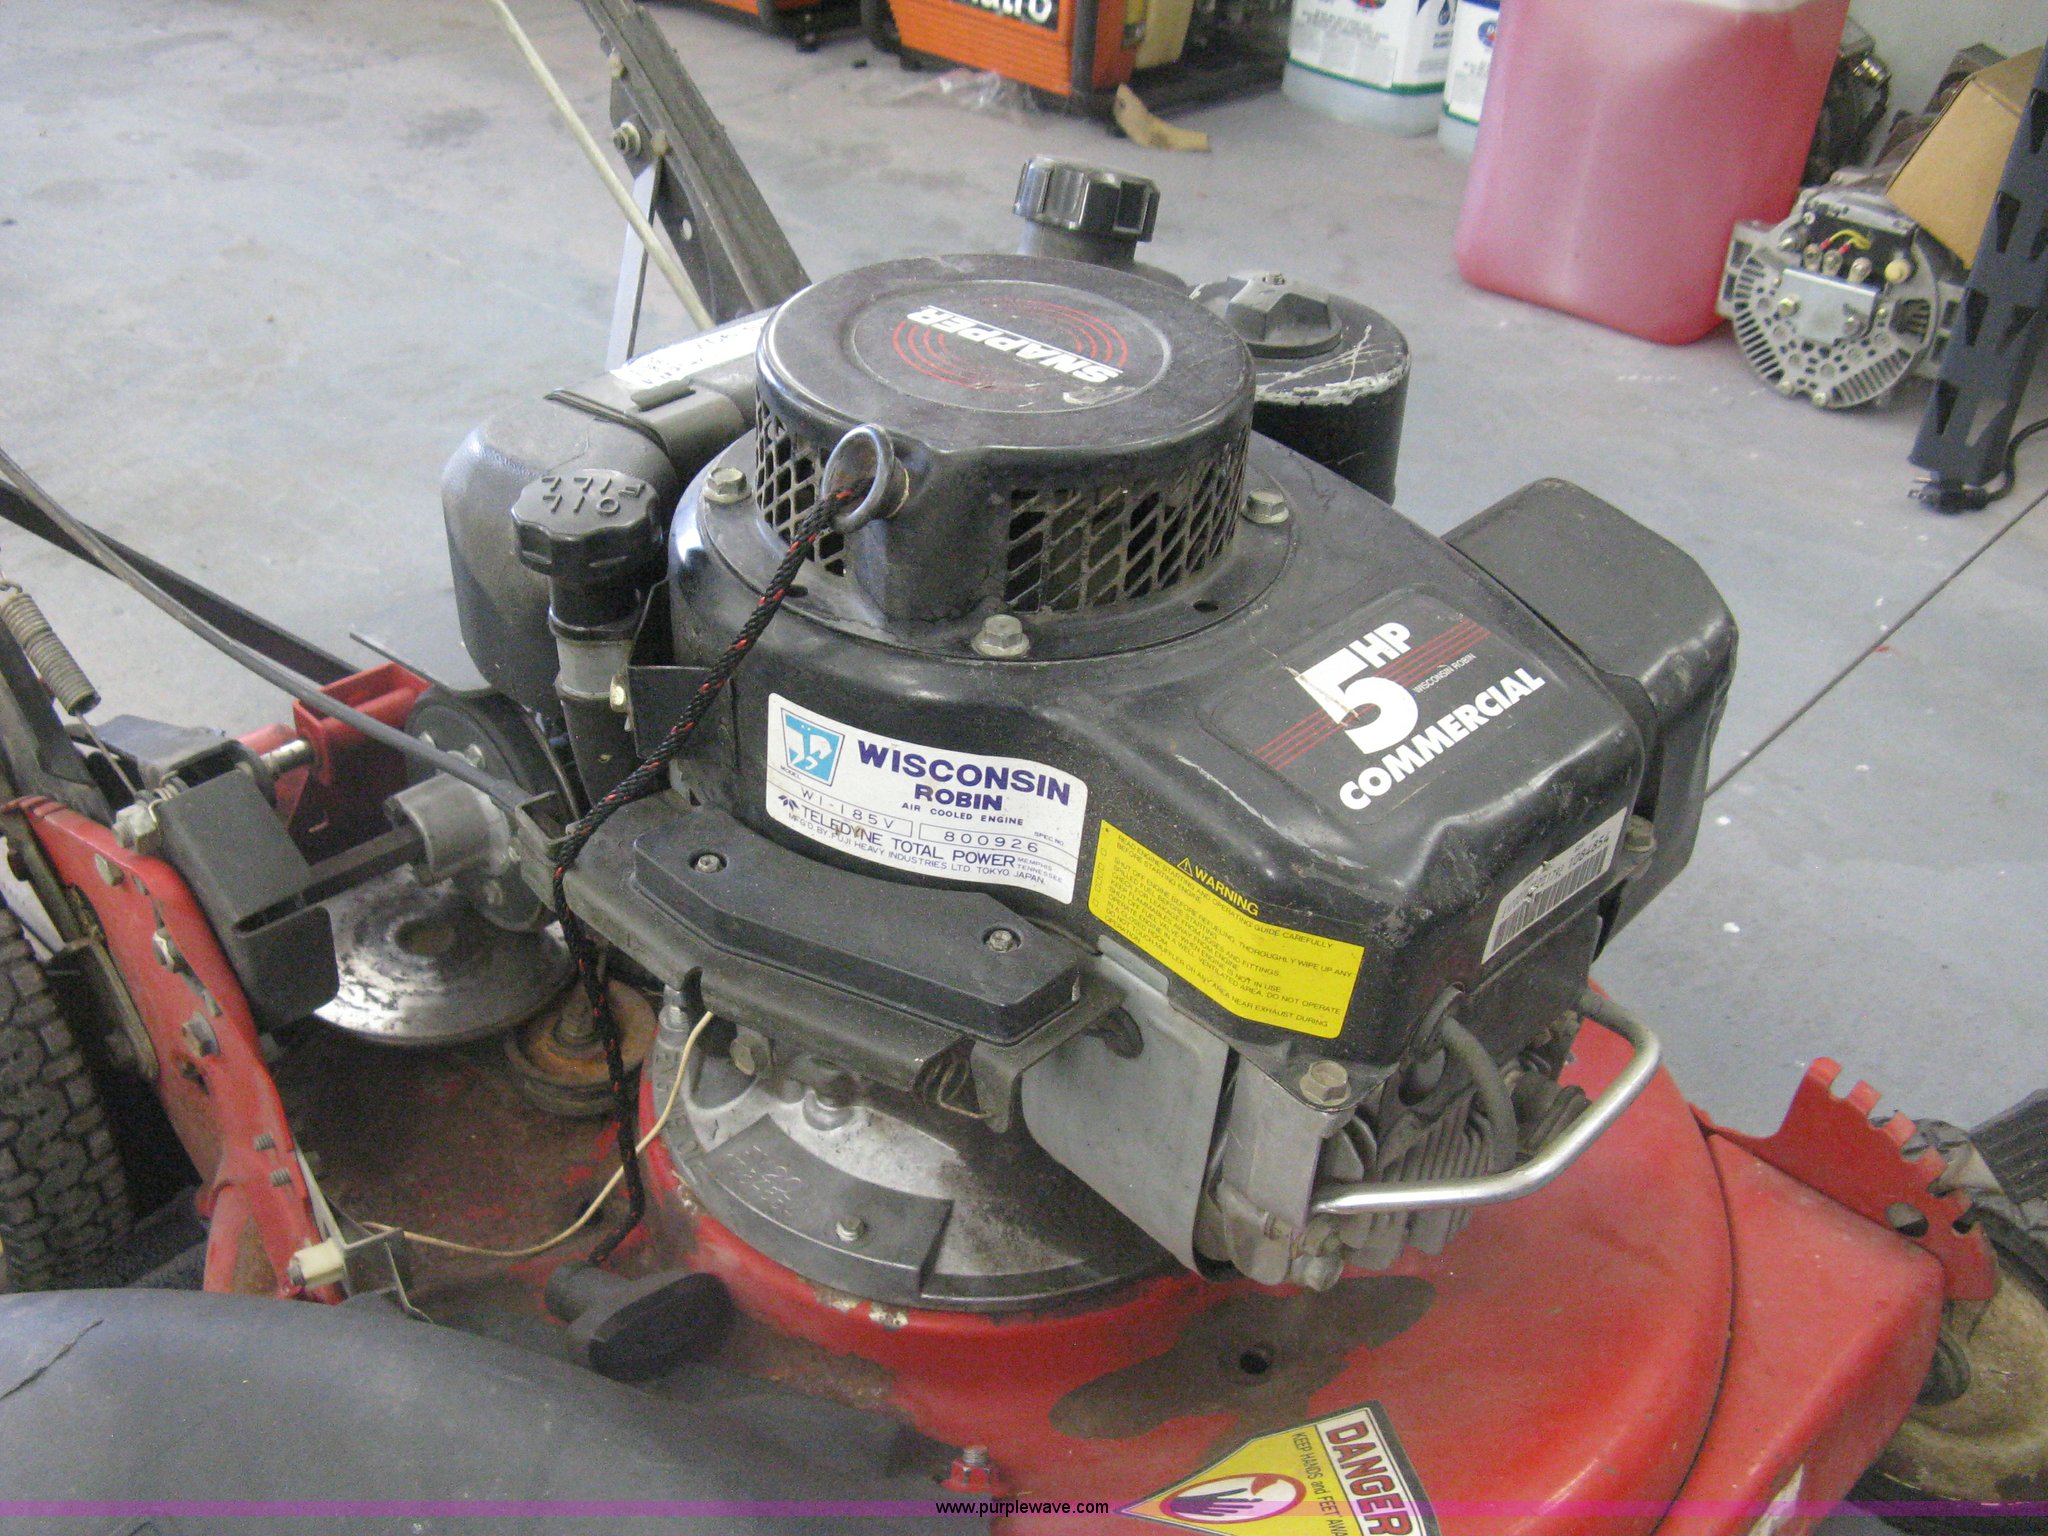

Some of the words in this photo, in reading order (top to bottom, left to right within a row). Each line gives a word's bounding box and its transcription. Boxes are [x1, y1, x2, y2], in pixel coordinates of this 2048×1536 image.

[907, 306, 1121, 383] SNAPPER
[1349, 622, 1411, 668] HP
[1412, 664, 1455, 693] WISCONSIN
[1451, 653, 1478, 669] ROBIN
[1295, 648, 1419, 755] 5
[1339, 667, 1546, 810] COMMERCIAL
[857, 740, 1070, 806] WISCONSIN
[902, 802, 921, 811] AIR
[930, 808, 973, 821] COOLED
[981, 815, 1024, 826] ENGINE
[914, 783, 1003, 811] ROBIN
[801, 804, 883, 846] TELEDYNE
[891, 837, 944, 860] TOTAL
[952, 850, 1016, 868] POWER
[944, 831, 1039, 853] 800926
[854, 841, 885, 856] HEAVY
[888, 849, 948, 870] INDUSTRIES
[1017, 857, 1053, 871] MEMPHIS
[1017, 863, 1063, 884] TENNESSEE
[1195, 866, 1259, 917] WARNING
[1212, 897, 1252, 928] OPERATING
[1253, 924, 1280, 937] GUIDE
[1281, 931, 1333, 949] CAREFULLY
[1200, 950, 1227, 972] ENGINE
[1234, 973, 1251, 985] NOT
[1253, 980, 1262, 988] IN
[1264, 983, 1281, 992] USE
[1225, 950, 1241, 964] AND
[1241, 959, 1279, 977] FITTINGS
[1238, 940, 1295, 965] THOROUGHLY
[1297, 959, 1318, 970] WIPE
[1320, 964, 1333, 973] UP
[1333, 967, 1352, 978] ANY
[1197, 955, 1238, 987] VENTILATED
[1265, 991, 1279, 1000] DO
[1280, 995, 1300, 1005] NOT
[1300, 999, 1341, 1015] OPERATE
[1230, 995, 1254, 1009] NEAR
[1254, 1003, 1294, 1019] EXHAUST
[1295, 1013, 1328, 1028] DURING
[1292, 1432, 1312, 1452] KEEP
[1301, 1452, 1324, 1480] HANDS
[1325, 1420, 1413, 1535] DANGER
[1311, 1480, 1329, 1495] and
[1319, 1495, 1341, 1516] FEET
